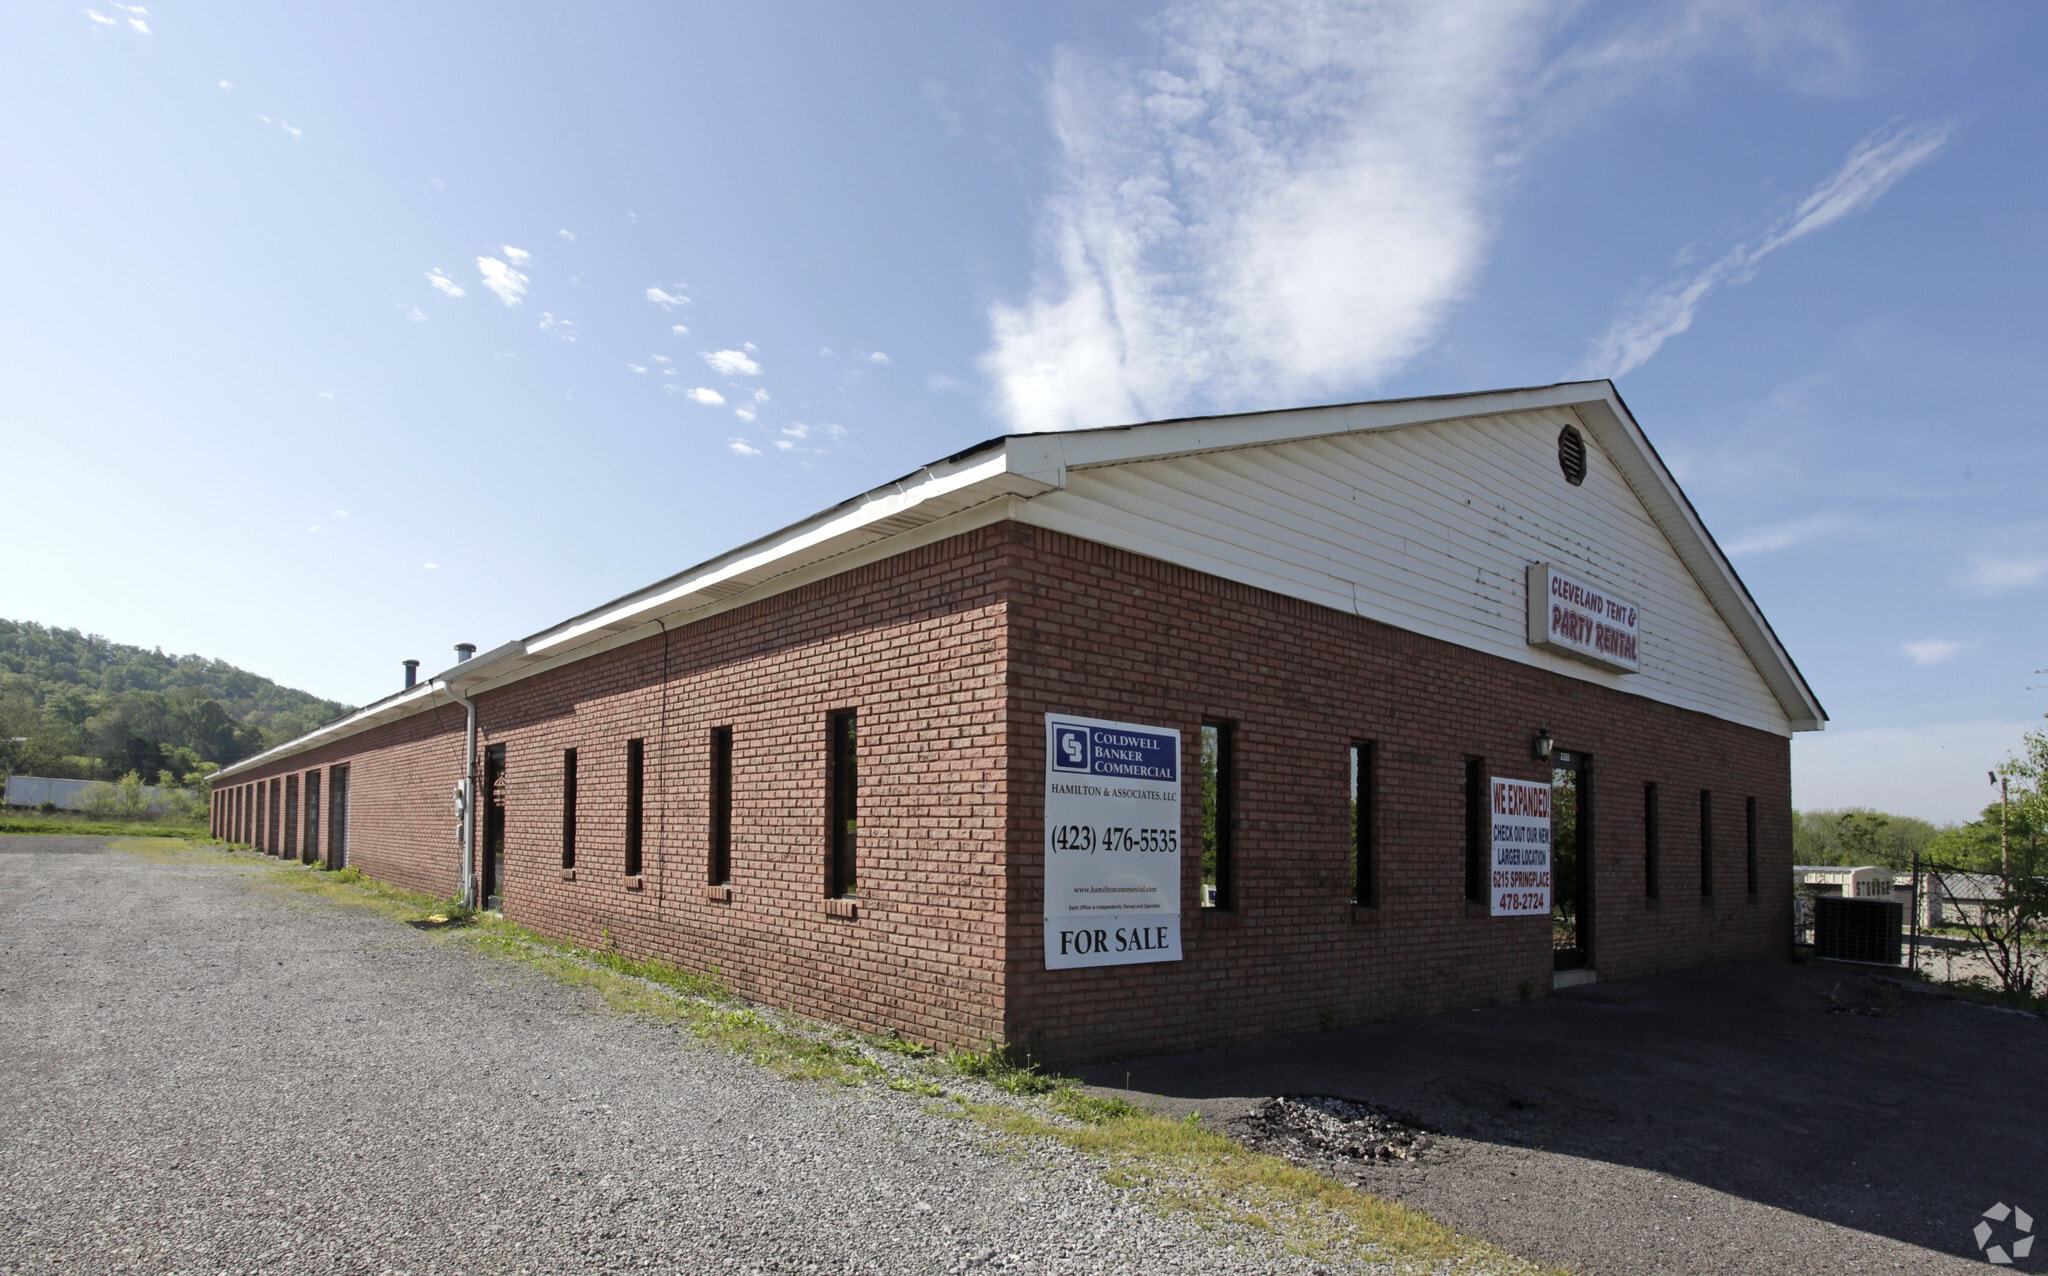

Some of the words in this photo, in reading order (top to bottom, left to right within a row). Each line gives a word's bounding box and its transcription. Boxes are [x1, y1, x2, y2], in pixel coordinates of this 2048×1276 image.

[1552, 576, 1603, 614] CLEVELAND
[1606, 599, 1627, 624] TENT
[1628, 607, 1636, 627] &
[1552, 603, 1593, 646] PARTY
[1595, 621, 1637, 662] RENTAL
[1094, 732, 1160, 750] COLDWELL
[1094, 746, 1143, 762] BANKER
[1094, 761, 1174, 779] COMMERCIAL
[1051, 783, 1101, 796] HAMILTON
[1104, 787, 1110, 797] &
[1112, 788, 1161, 802] ASSOCIATES,
[1163, 791, 1177, 801] LLC
[1493, 783, 1506, 815] WE
[1508, 784, 1550, 818] EXPANDED!
[1051, 825, 1097, 855] (423)
[1102, 827, 1177, 852] 476-5535
[1494, 824, 1513, 841] CHECK
[1514, 826, 1525, 842] OUT
[1526, 827, 1537, 843] OUR
[1497, 848, 1521, 865] LARGER
[1521, 849, 1547, 866] LOCATION
[1493, 871, 1509, 888] 6215
[1510, 871, 1550, 888] SPRINGPLACE
[1073, 885, 1157, 893] www.hamiltoncommercial.com
[1499, 892, 1544, 910] 478-2724
[1060, 929, 1109, 955] FOR
[1115, 926, 1169, 952] SALE
